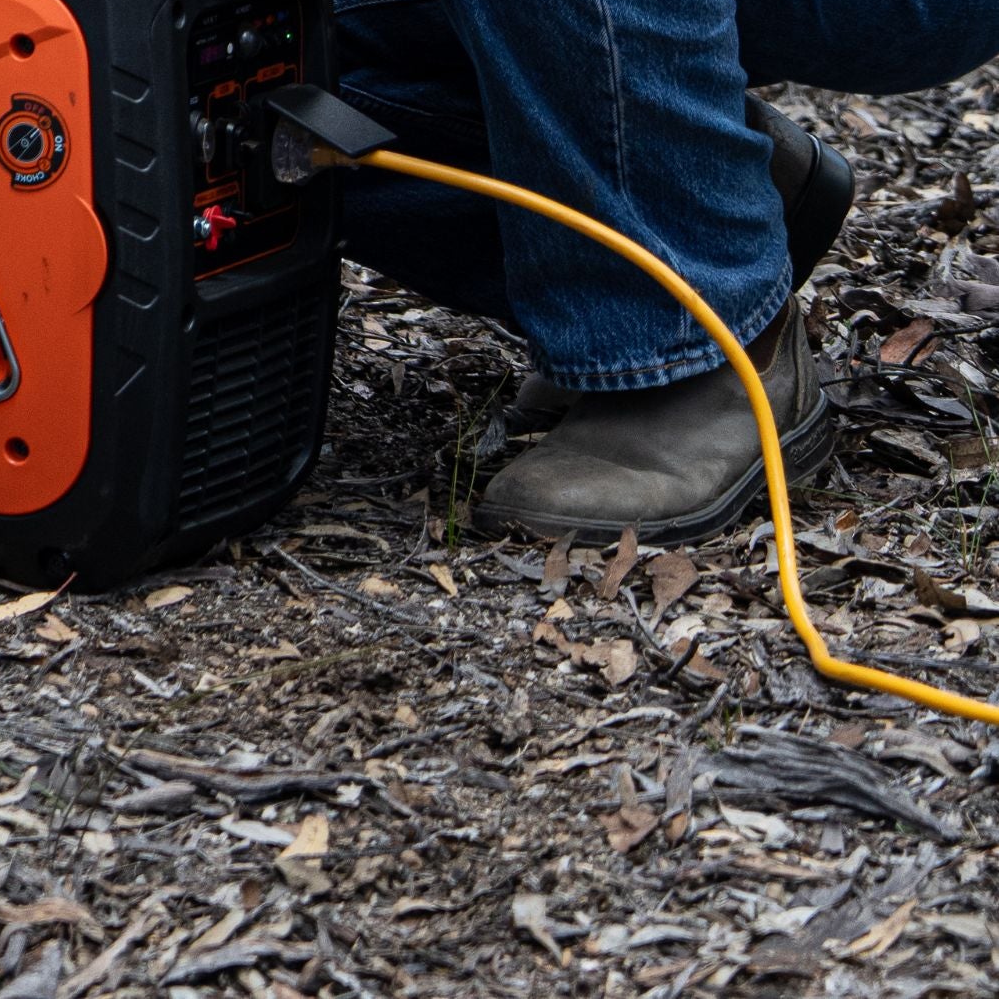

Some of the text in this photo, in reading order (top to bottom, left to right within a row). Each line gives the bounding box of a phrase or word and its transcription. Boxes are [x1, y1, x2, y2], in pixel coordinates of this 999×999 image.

[24, 102, 46, 114] OFF
[54, 135, 63, 153] ON
[14, 170, 45, 183] CHOKE
